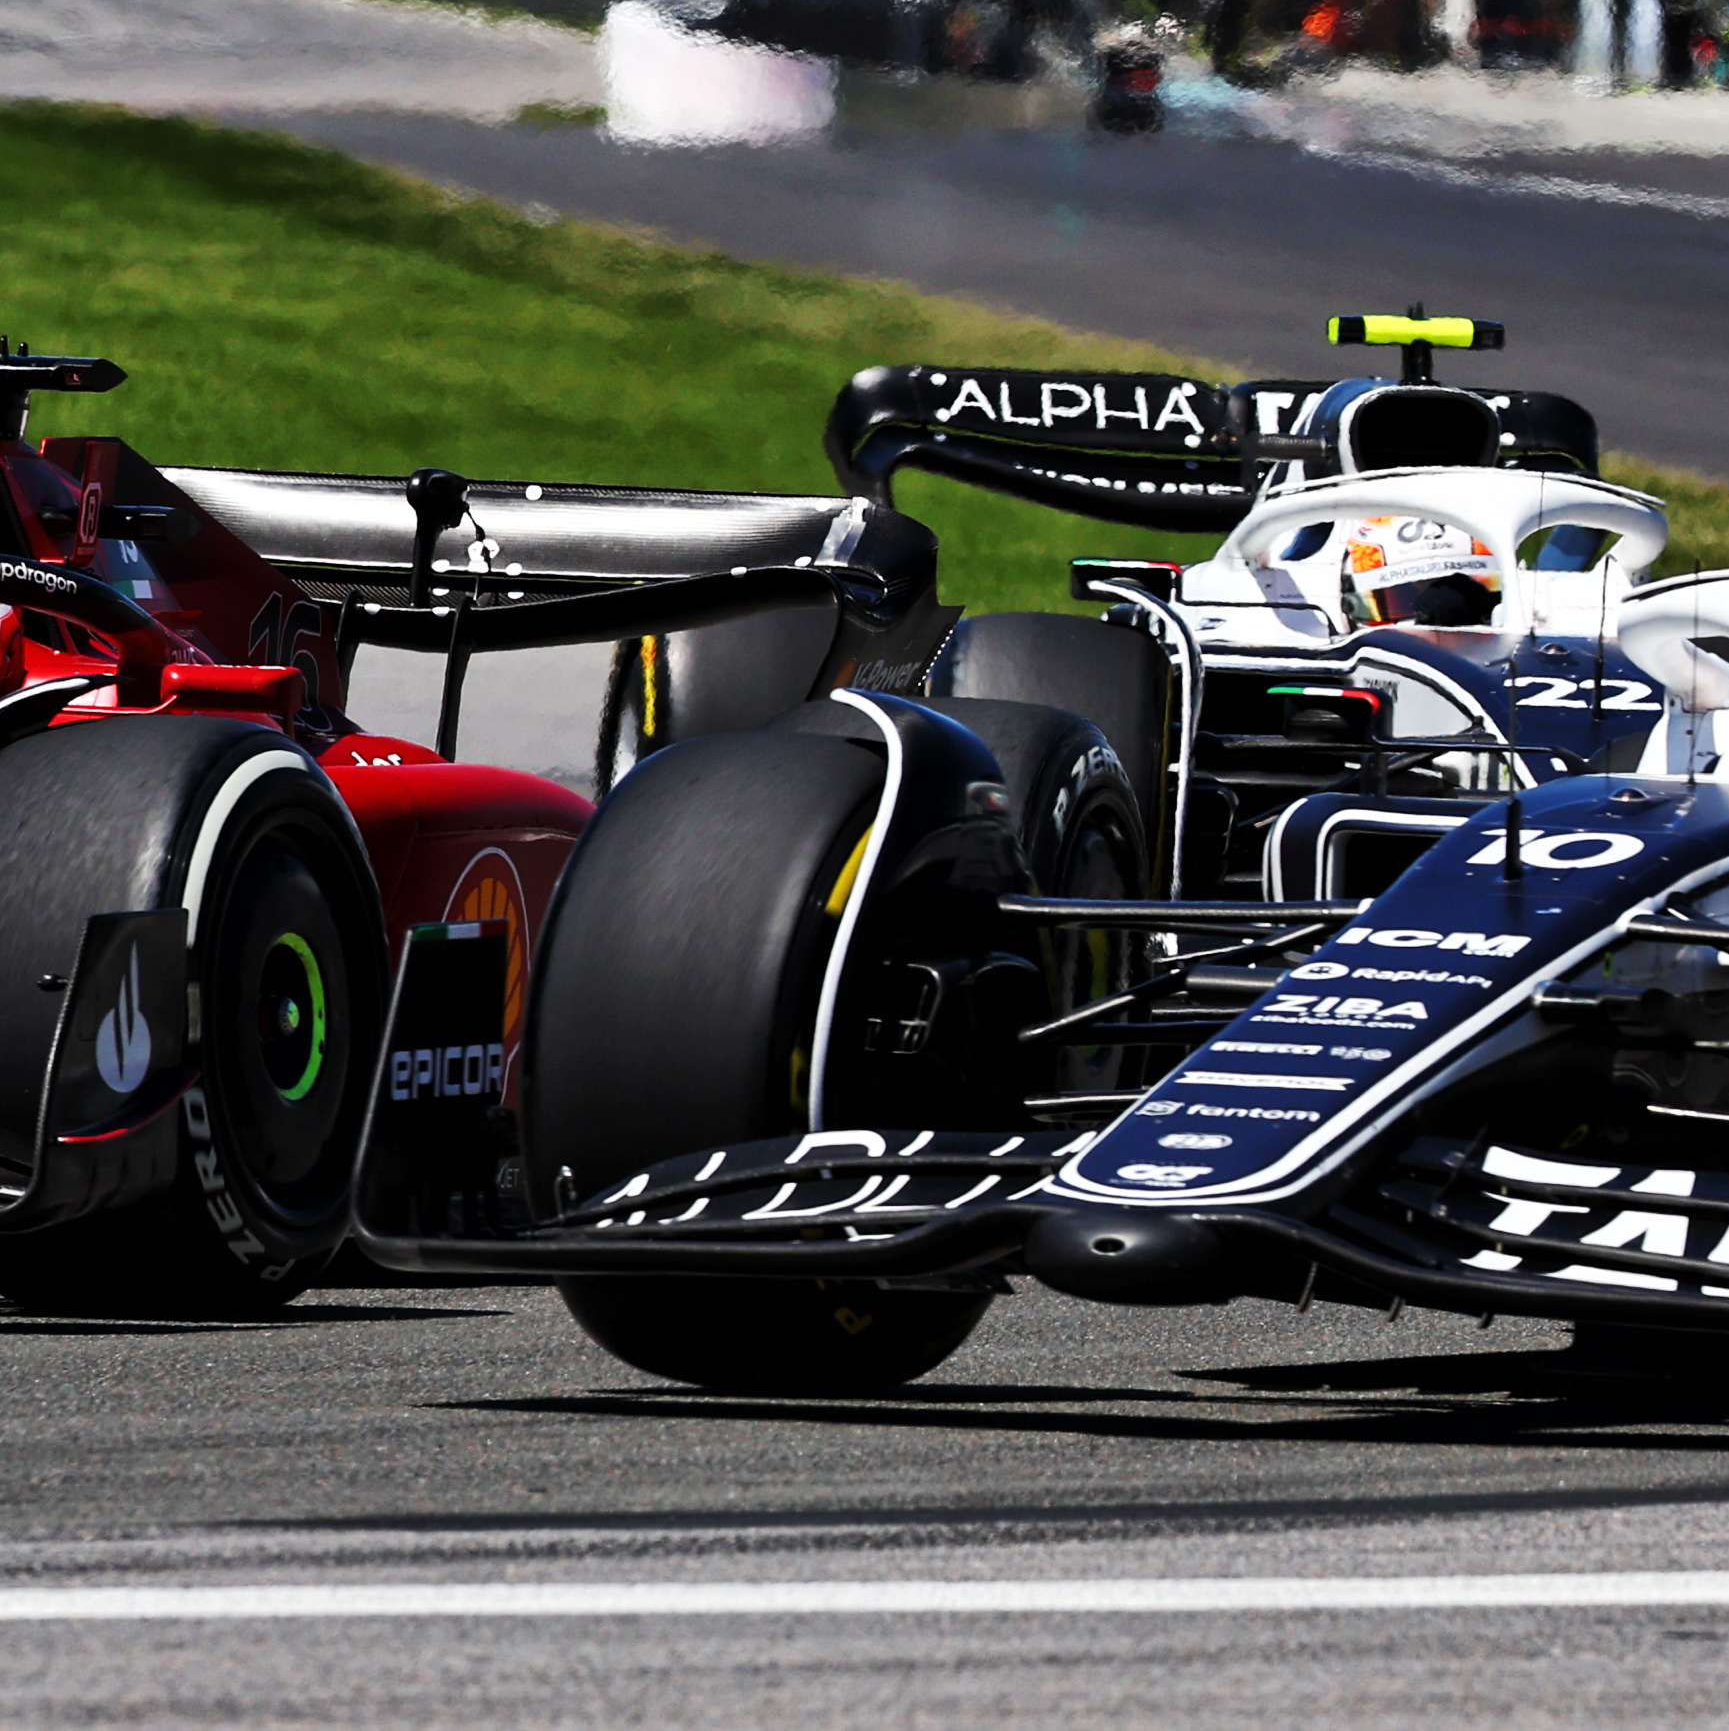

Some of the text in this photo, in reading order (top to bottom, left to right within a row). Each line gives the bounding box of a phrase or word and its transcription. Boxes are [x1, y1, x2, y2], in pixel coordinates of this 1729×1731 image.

[950, 378, 1205, 434] ALPHA
[1505, 676, 1663, 711] 22
[1466, 828, 1645, 870] 10
[1335, 927, 1533, 953] ICM
[1262, 994, 1430, 1020] ZIBA
[1186, 1103, 1321, 1122] fantom
[183, 1086, 266, 1264] ZERO
